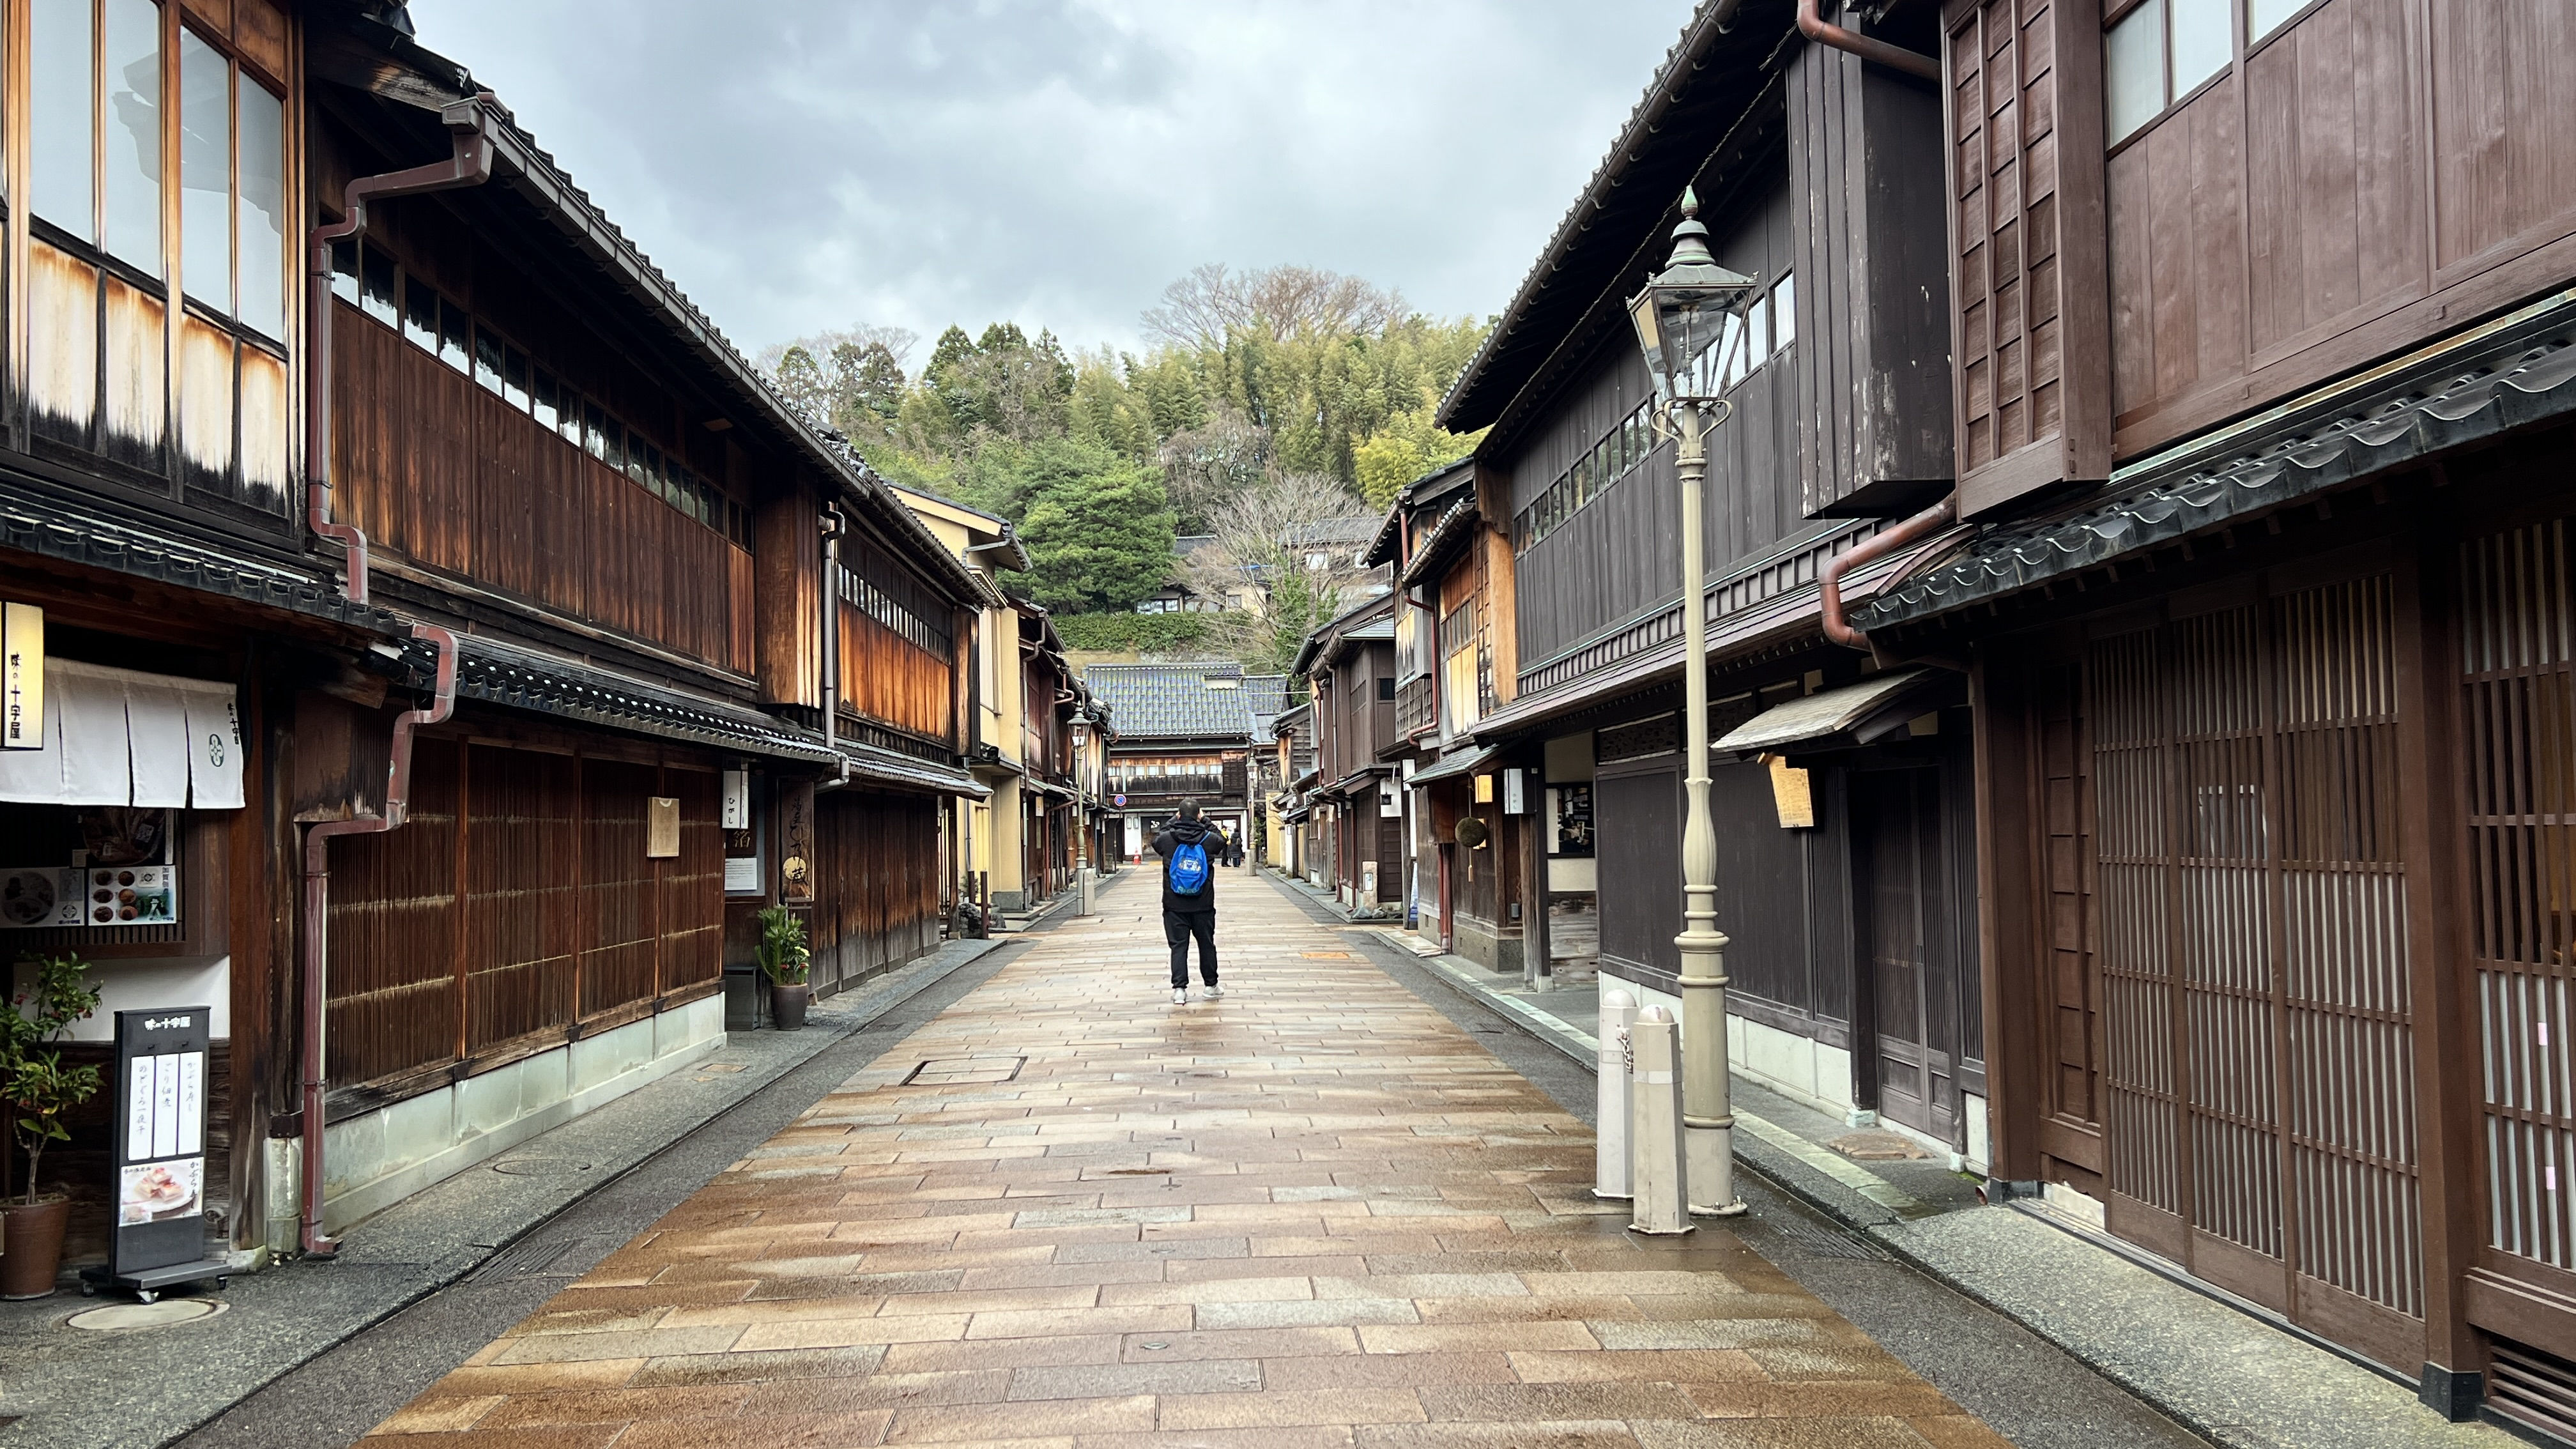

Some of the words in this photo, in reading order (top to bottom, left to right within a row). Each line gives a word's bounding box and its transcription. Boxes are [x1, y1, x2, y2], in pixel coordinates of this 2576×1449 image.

[10, 651, 21, 739] 味の十字屋
